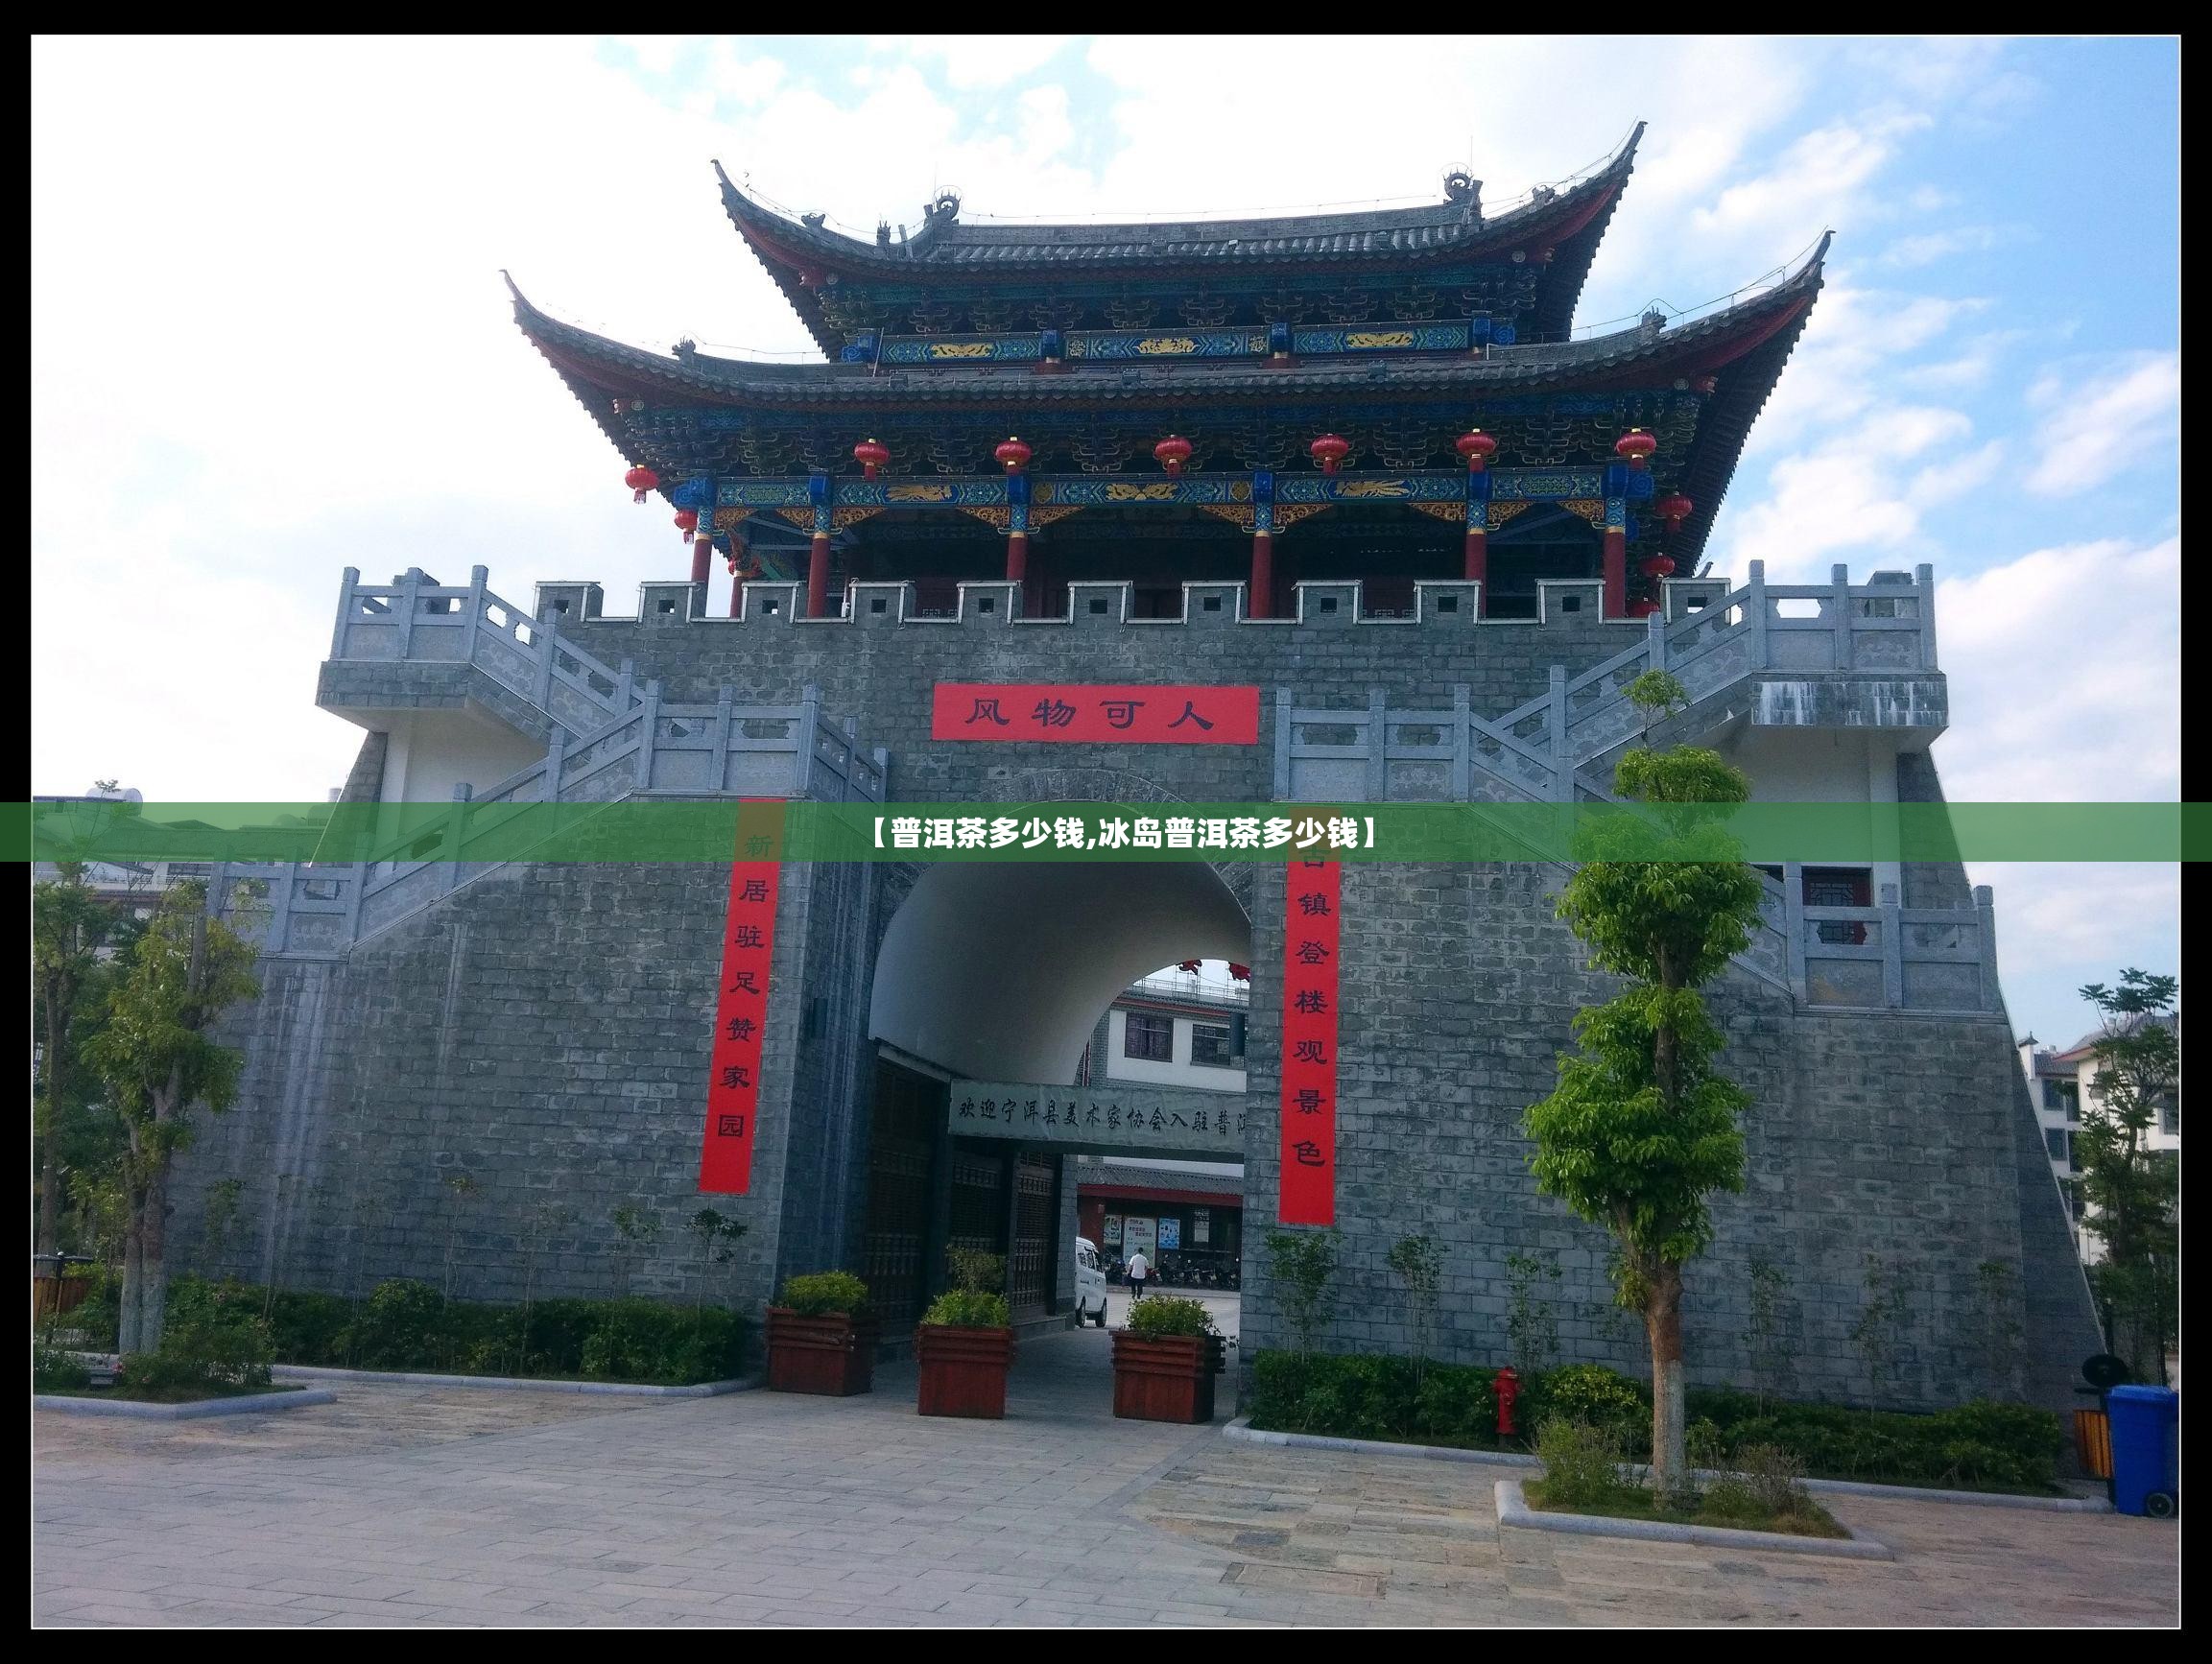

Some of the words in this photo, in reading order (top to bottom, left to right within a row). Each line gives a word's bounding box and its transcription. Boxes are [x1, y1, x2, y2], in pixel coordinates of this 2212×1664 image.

[964, 699, 1214, 730] 风物可人
[717, 834, 774, 1138] 新居驻足赞家园
[1292, 844, 1332, 1168] 古镇登楼观景色
